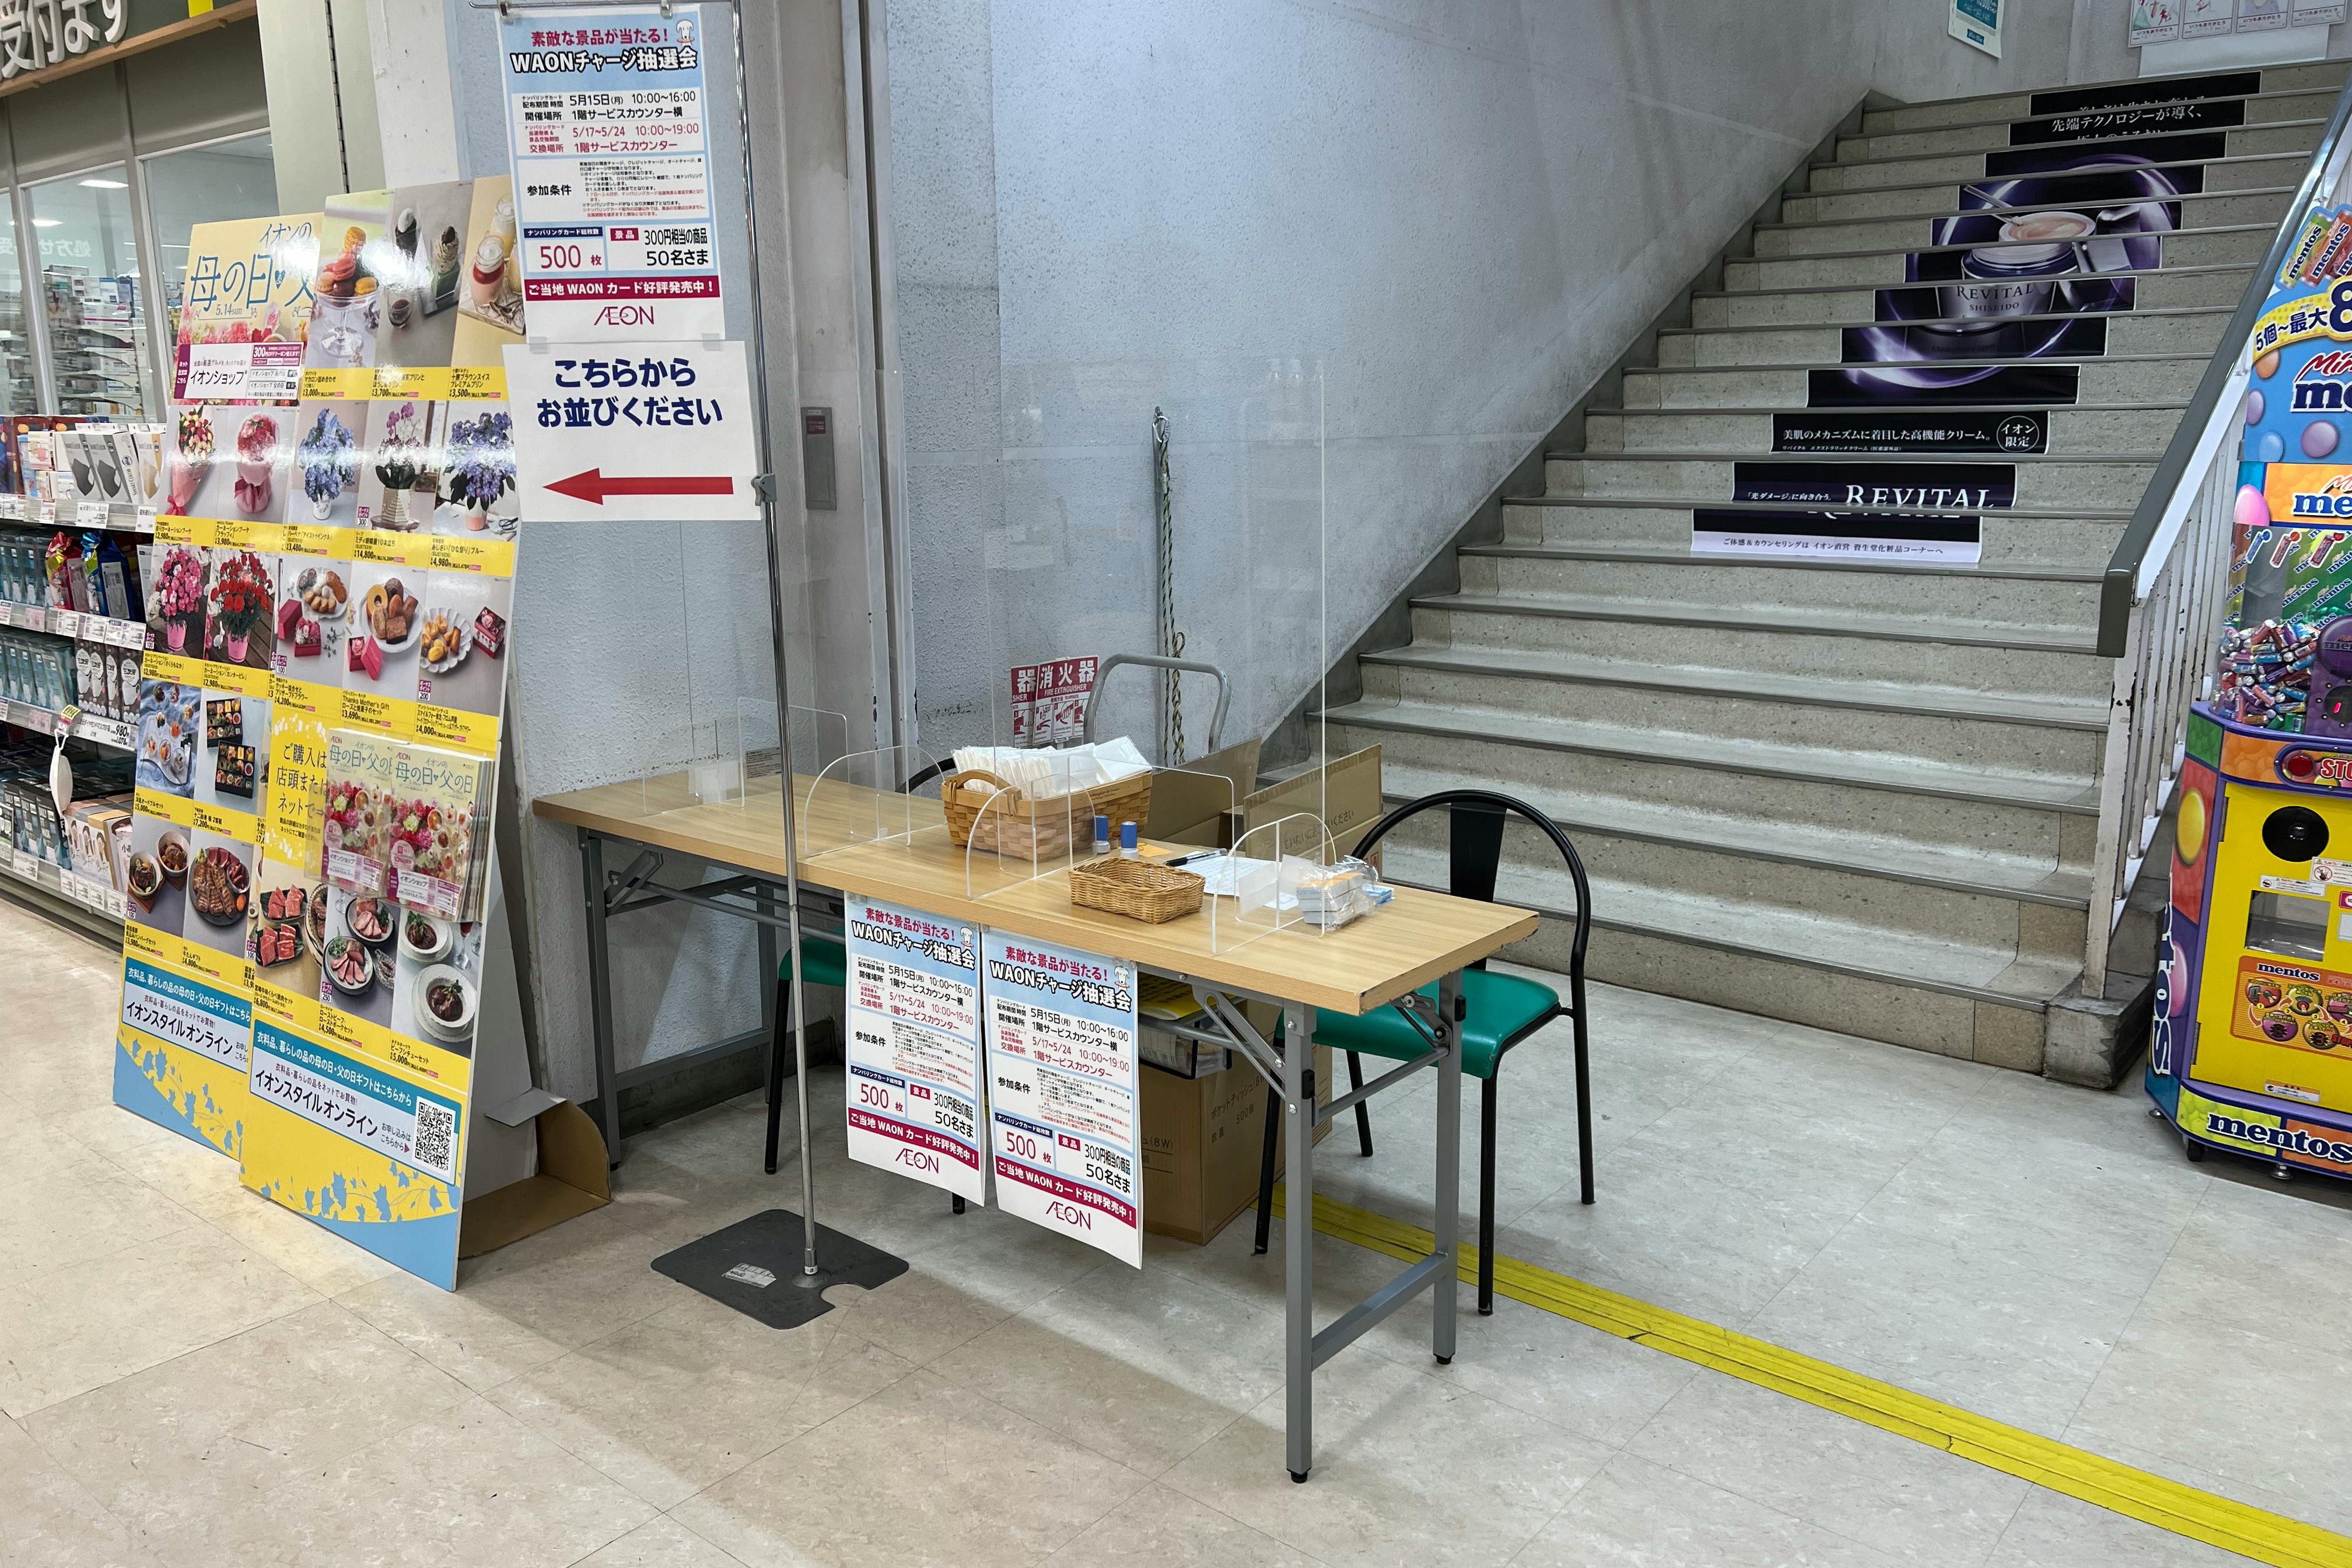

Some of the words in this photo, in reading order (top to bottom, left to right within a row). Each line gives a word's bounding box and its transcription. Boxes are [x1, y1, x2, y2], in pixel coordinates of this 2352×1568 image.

[531, 28, 667, 47] 素敵な景品が当たる!
[510, 46, 698, 74] WAONチャージ抽選会
[527, 185, 572, 196] 参加条件
[645, 228, 708, 246] 300円相当の商品
[540, 244, 581, 269] 500
[646, 249, 709, 266] 50名さま
[2288, 226, 2321, 279] mentos
[2311, 223, 2350, 278] mentos
[1957, 284, 2034, 300] REVITAL
[1969, 303, 2019, 311] SHISEIDO
[191, 370, 244, 384] イオンショップ
[555, 358, 696, 388] こちらから
[537, 396, 722, 427] お並びください
[1783, 429, 1990, 441] 美肌のメカニズムに着目した高機能クリーム。
[2001, 424, 2036, 435] イオン
[2006, 436, 2030, 447] 限定
[1846, 485, 1994, 509] REVITAL
[2312, 578, 2351, 607] mentos
[1040, 660, 1095, 689] 消火器
[1055, 684, 1087, 695] EXTINGUISHER
[284, 743, 327, 768] ご購入は
[866, 907, 955, 941] 素敵な景品が当たる!
[852, 920, 975, 971] WAONチャージ抽選会
[1006, 946, 1107, 981] 素敵な景品が当たる!
[2257, 963, 2320, 981] mentos
[990, 960, 1132, 1013] WAONチャージ抽選会
[855, 1031, 886, 1046] 参加条件
[257, 1031, 412, 1106] 衣料品、暮らしの品の母の日・父の日ギフトはこちらから
[861, 1083, 888, 1109] 500
[998, 1077, 1030, 1094] 参加条件
[382, 1122, 411, 1142] お申し込みは
[935, 1111, 974, 1139] 50名さま
[2207, 1112, 2352, 1163] mentos
[381, 1134, 404, 1151] こちらから
[1007, 1132, 1035, 1160] 500
[1086, 1164, 1130, 1194] 50名さま
